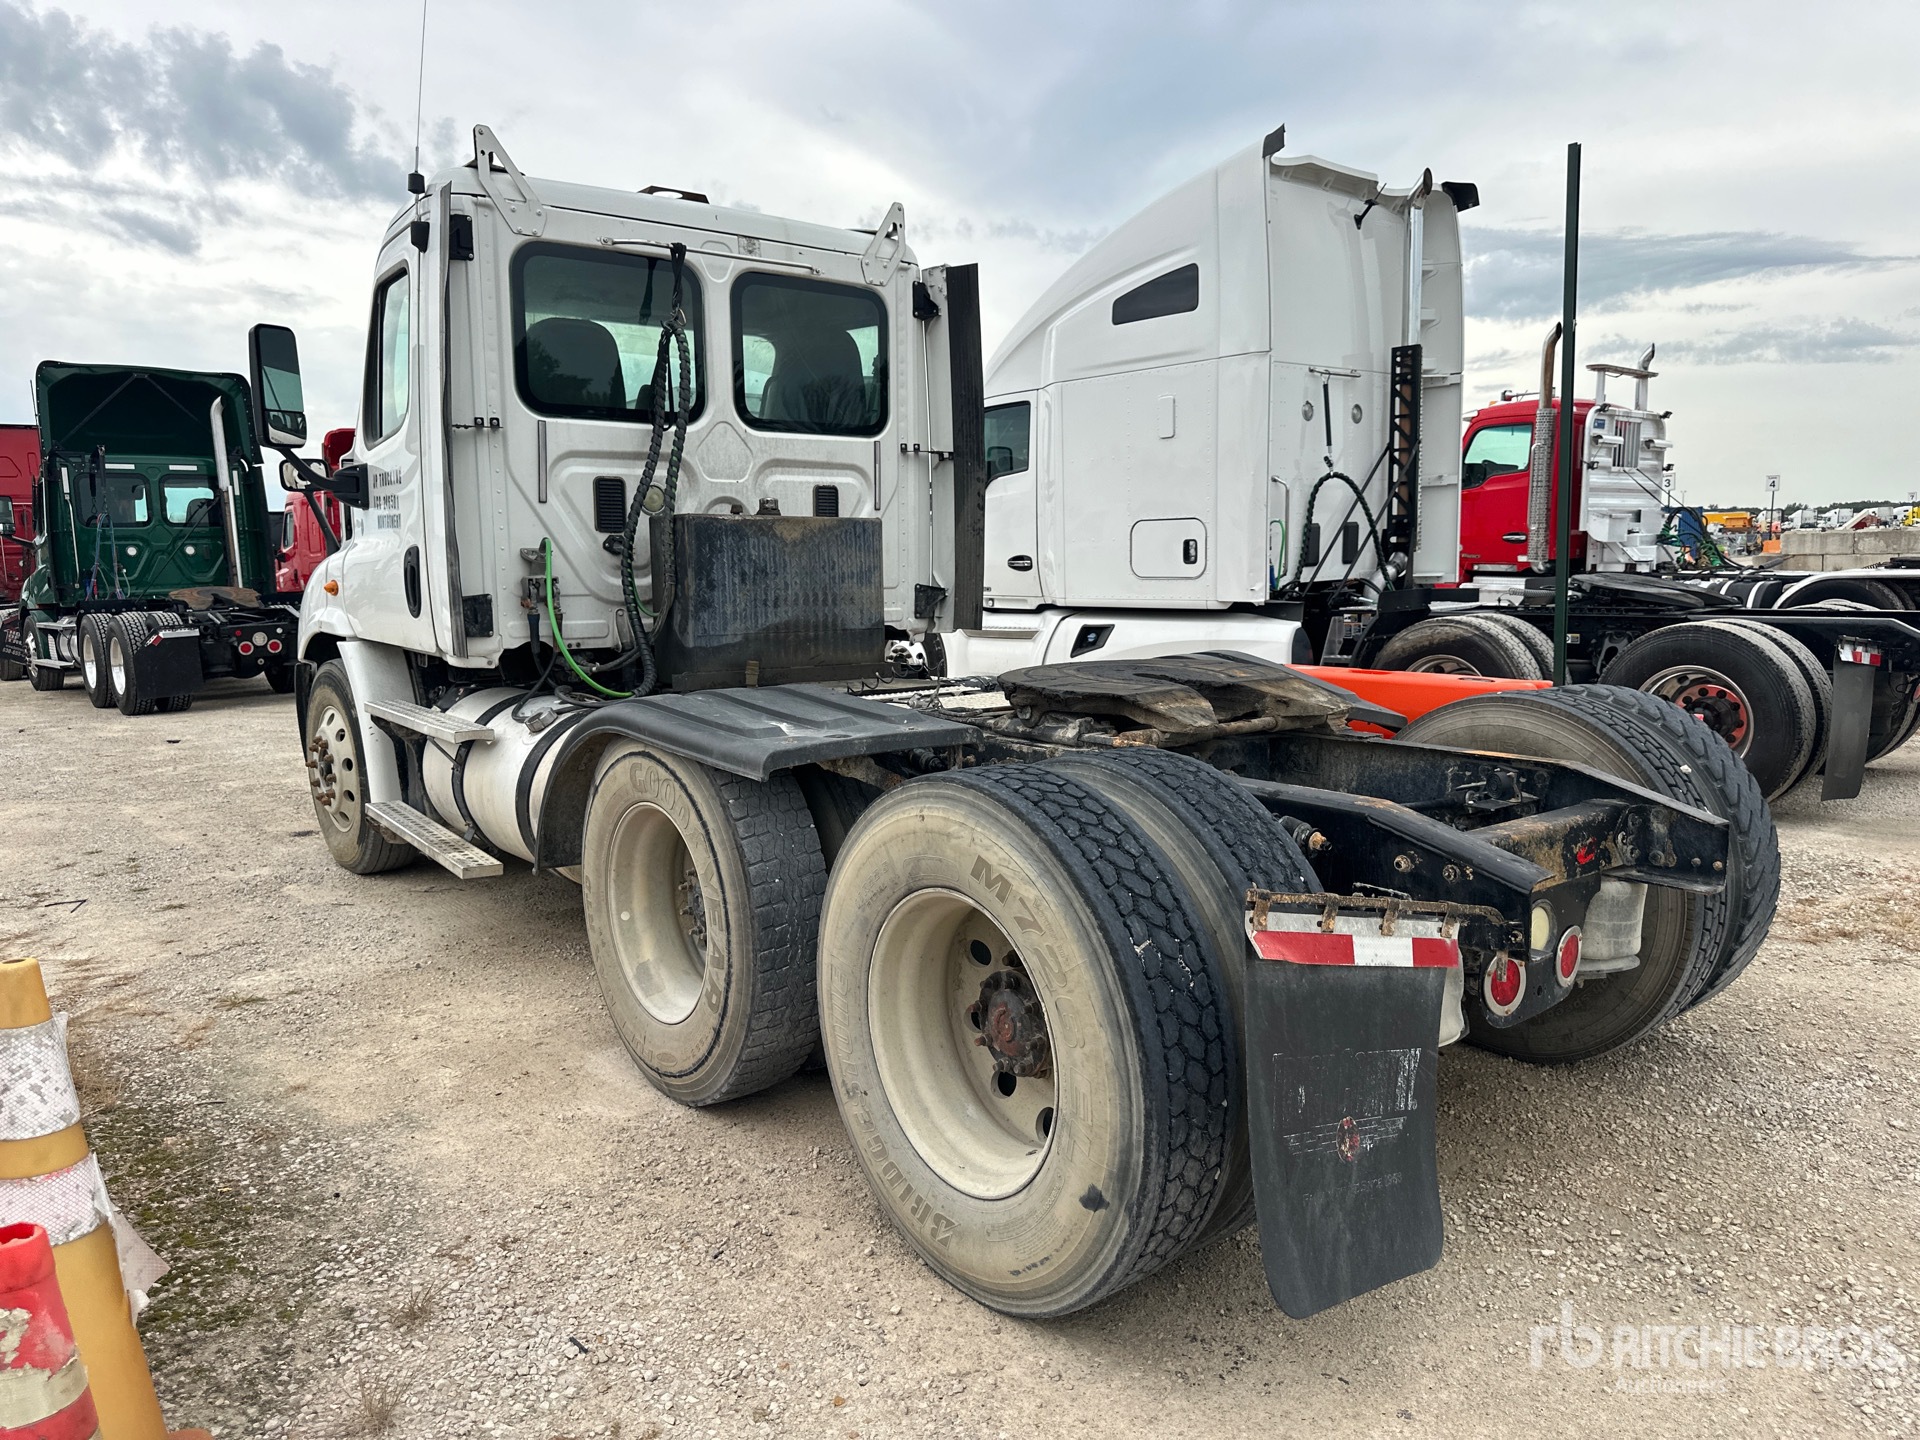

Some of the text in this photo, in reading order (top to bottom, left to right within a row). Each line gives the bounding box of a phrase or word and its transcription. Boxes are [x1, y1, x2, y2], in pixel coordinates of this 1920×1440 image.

[379, 469, 402, 487] TRUCKING
[1664, 478, 1671, 488] 3
[1769, 480, 1776, 489] 4
[629, 761, 726, 1014] GOODYEAR
[969, 854, 1086, 1048] M726
[829, 960, 961, 1250] BRIDGESTONE
